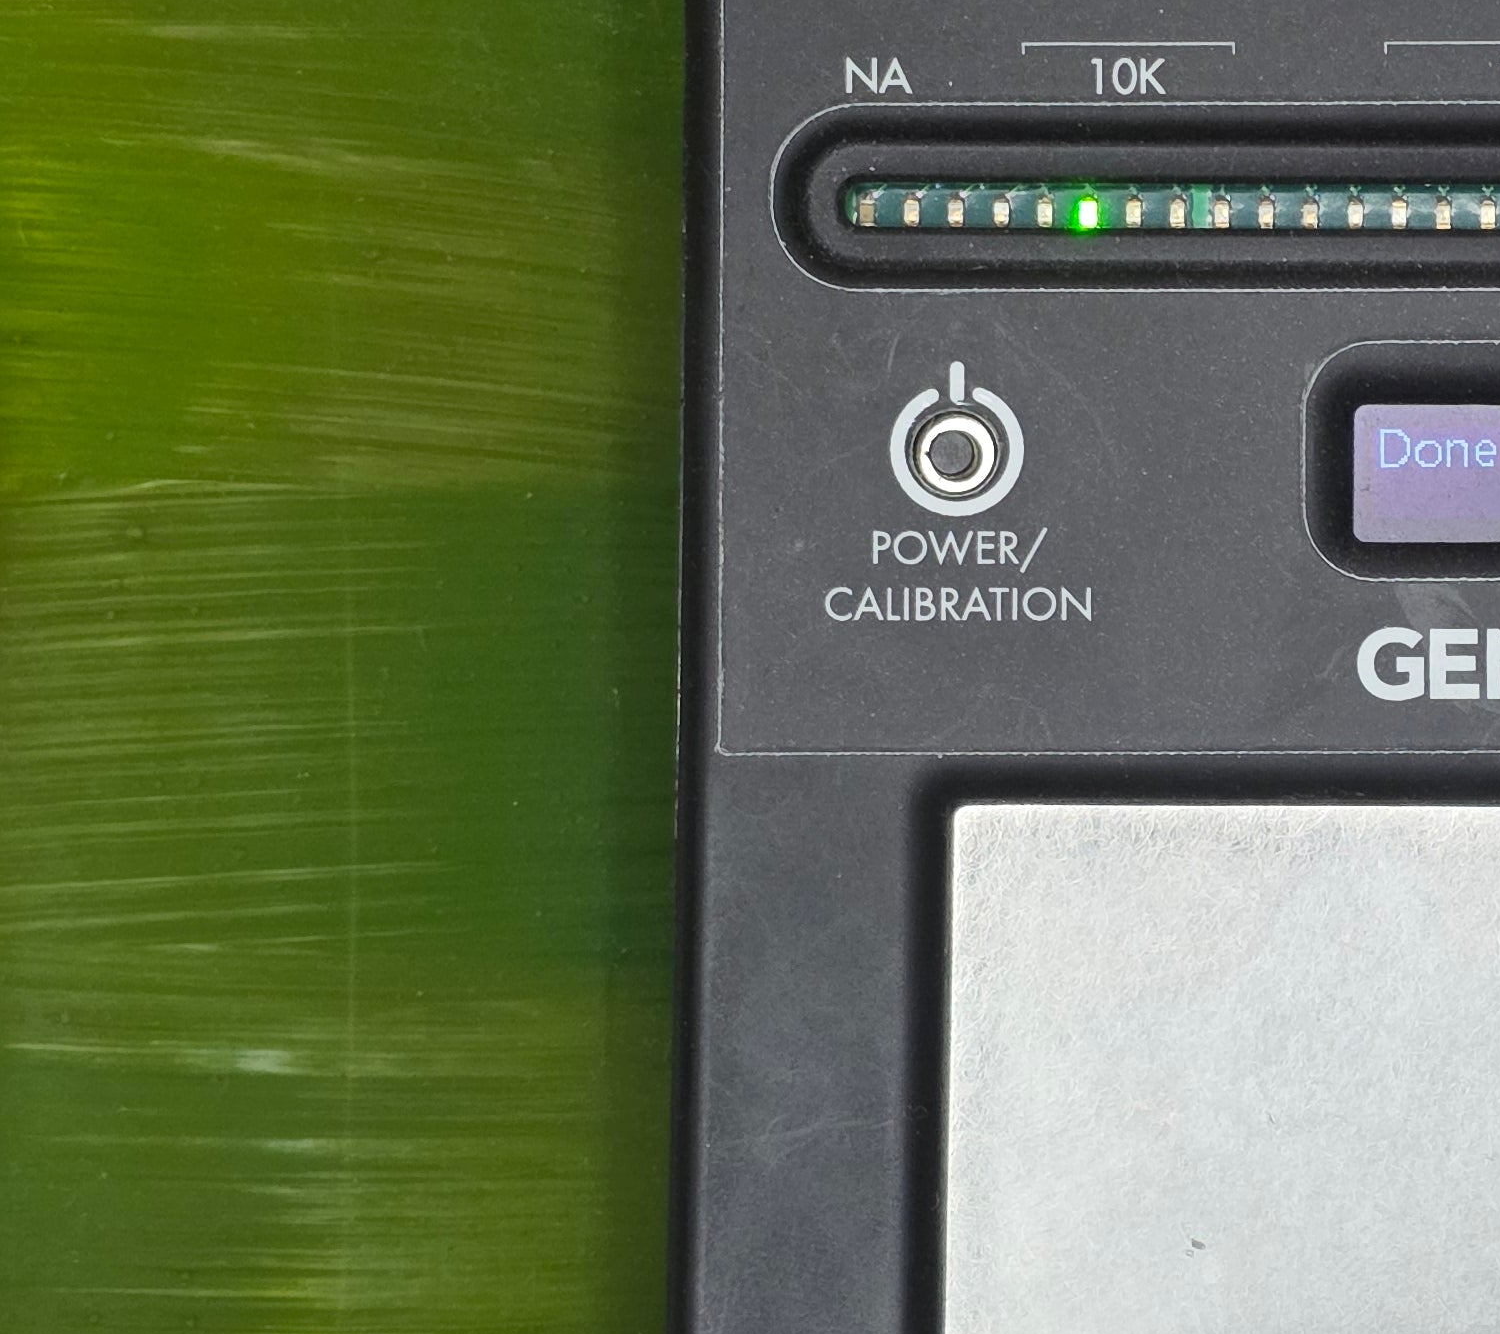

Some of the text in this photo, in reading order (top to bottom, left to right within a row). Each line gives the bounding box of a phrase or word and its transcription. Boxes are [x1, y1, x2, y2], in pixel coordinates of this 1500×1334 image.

[844, 56, 913, 95] NA
[1090, 56, 1167, 96] 10K
[1379, 428, 1497, 468] Done
[872, 526, 1048, 574] POWER/
[824, 586, 1092, 622] CALIBRATION
